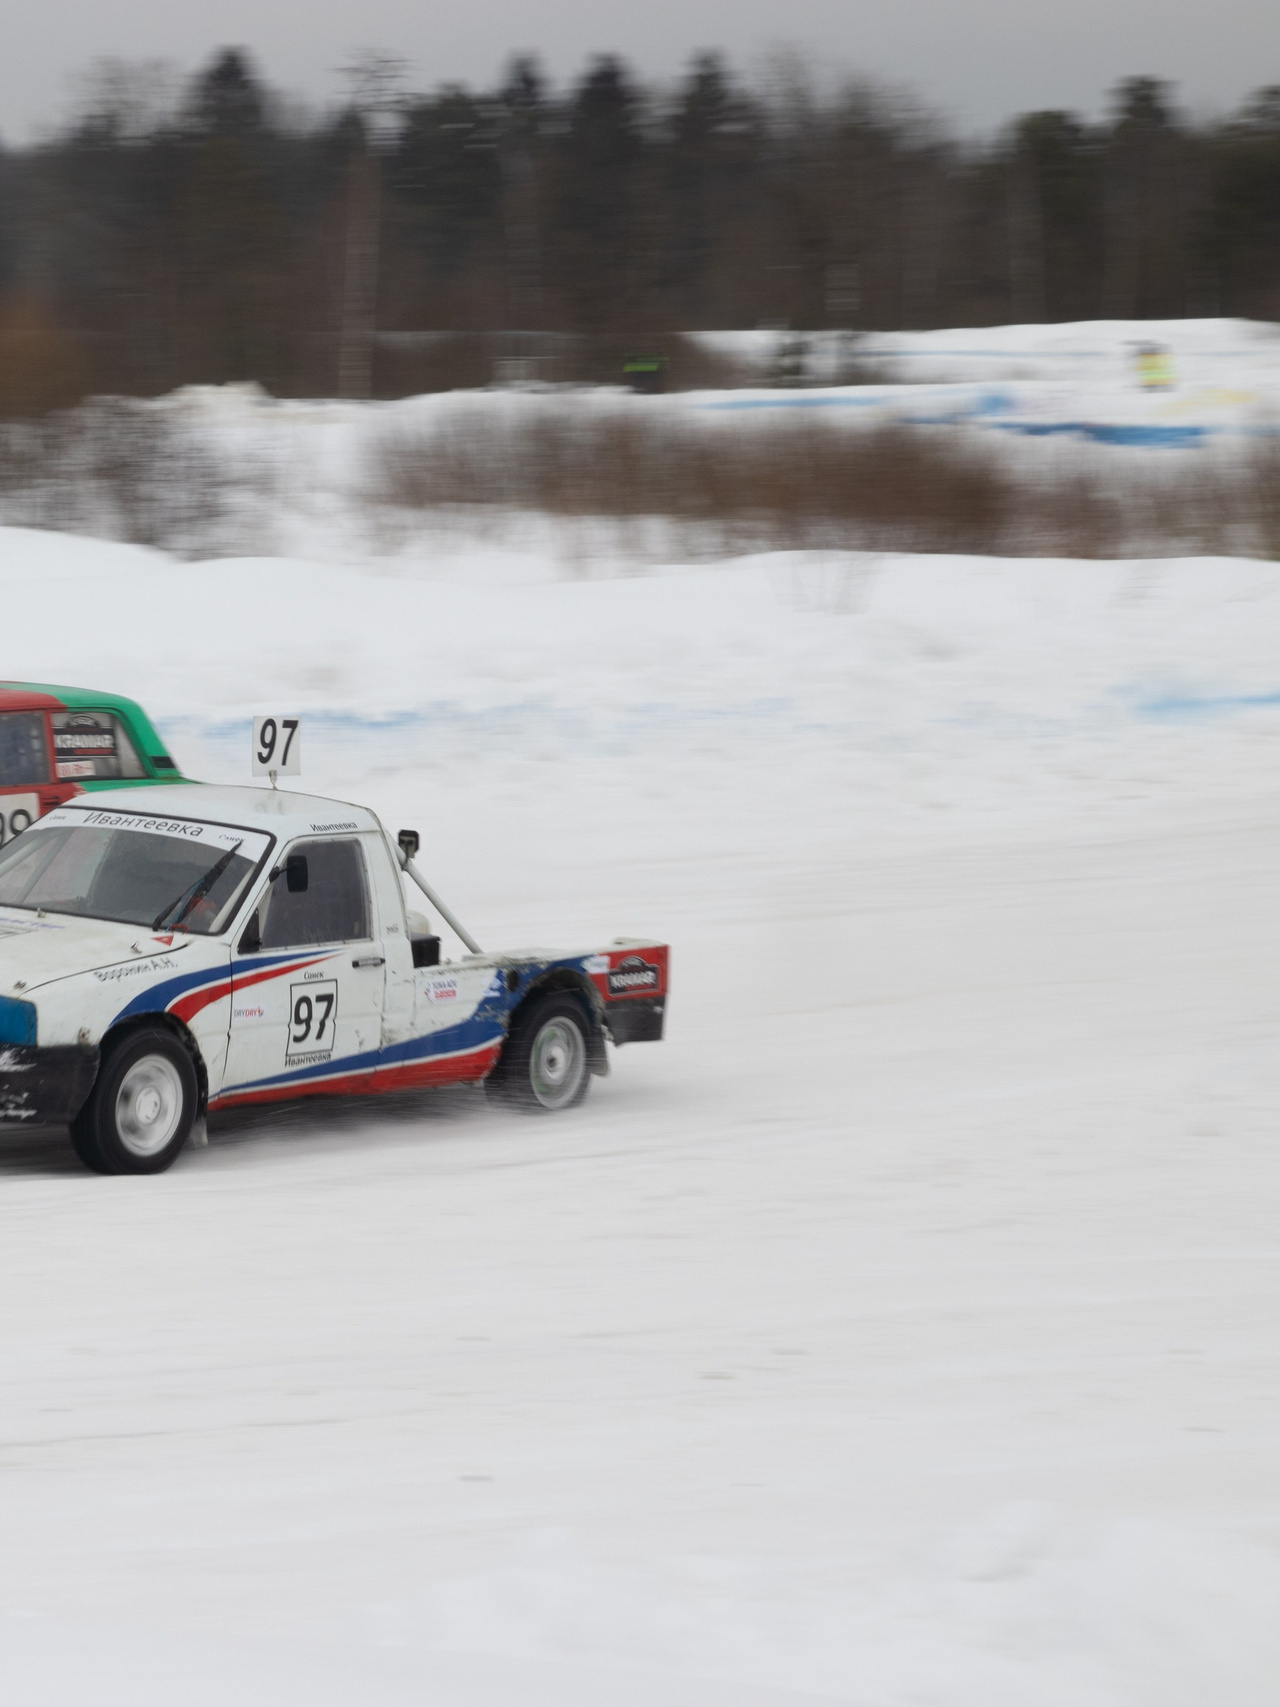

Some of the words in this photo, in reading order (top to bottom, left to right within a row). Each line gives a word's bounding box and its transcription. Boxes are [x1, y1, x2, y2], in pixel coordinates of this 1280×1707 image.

[257, 717, 299, 767] 97
[83, 811, 204, 838] Ивантеевка
[309, 821, 359, 833] Ивантеевка
[292, 993, 335, 1044] 97
[284, 1053, 332, 1068] Ивантеевка
